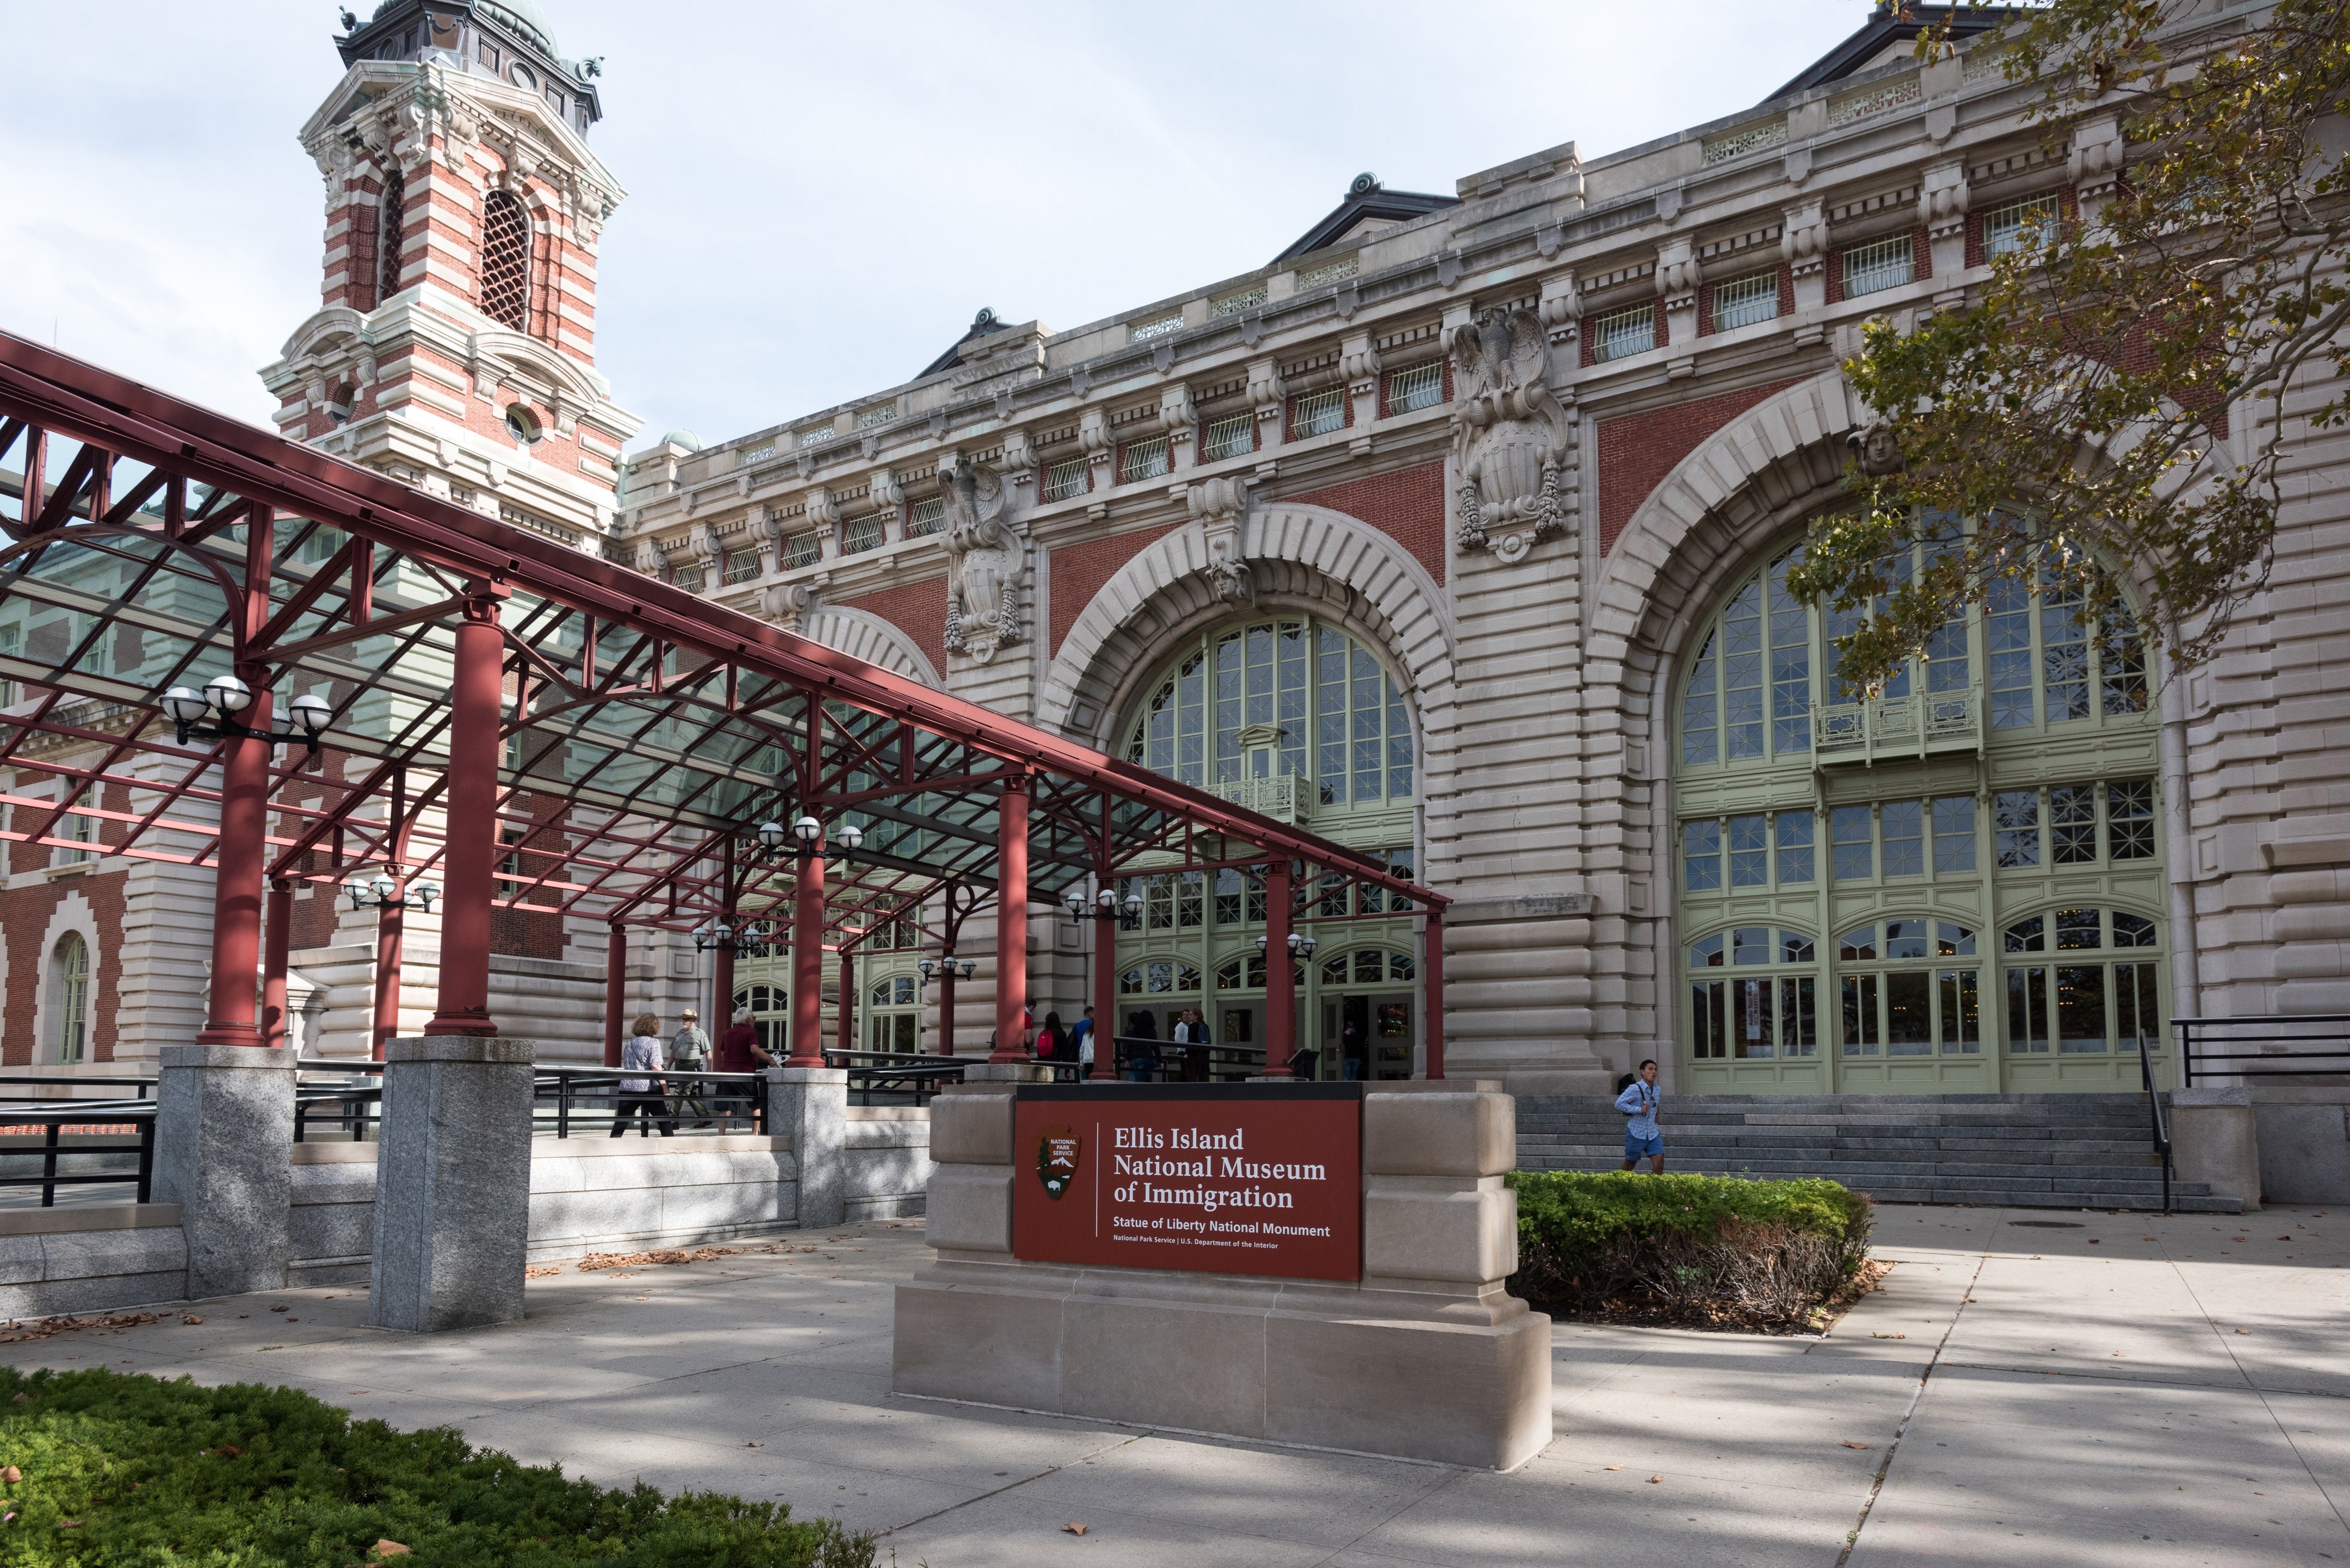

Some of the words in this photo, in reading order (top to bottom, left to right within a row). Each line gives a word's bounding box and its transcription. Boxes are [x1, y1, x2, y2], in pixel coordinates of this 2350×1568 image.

[1115, 1127, 1164, 1149] Ellis
[1171, 1128, 1244, 1150] Island
[1114, 1155, 1213, 1177] National
[1220, 1157, 1326, 1180] Museum
[1114, 1181, 1137, 1203] of
[1143, 1183, 1294, 1212] Immigration
[1114, 1216, 1148, 1229] Statue
[1151, 1218, 1164, 1229] of
[1167, 1219, 1206, 1234] Liberty
[1209, 1220, 1259, 1234] National
[1263, 1223, 1330, 1237] Monument
[1194, 1238, 1232, 1247] Department
